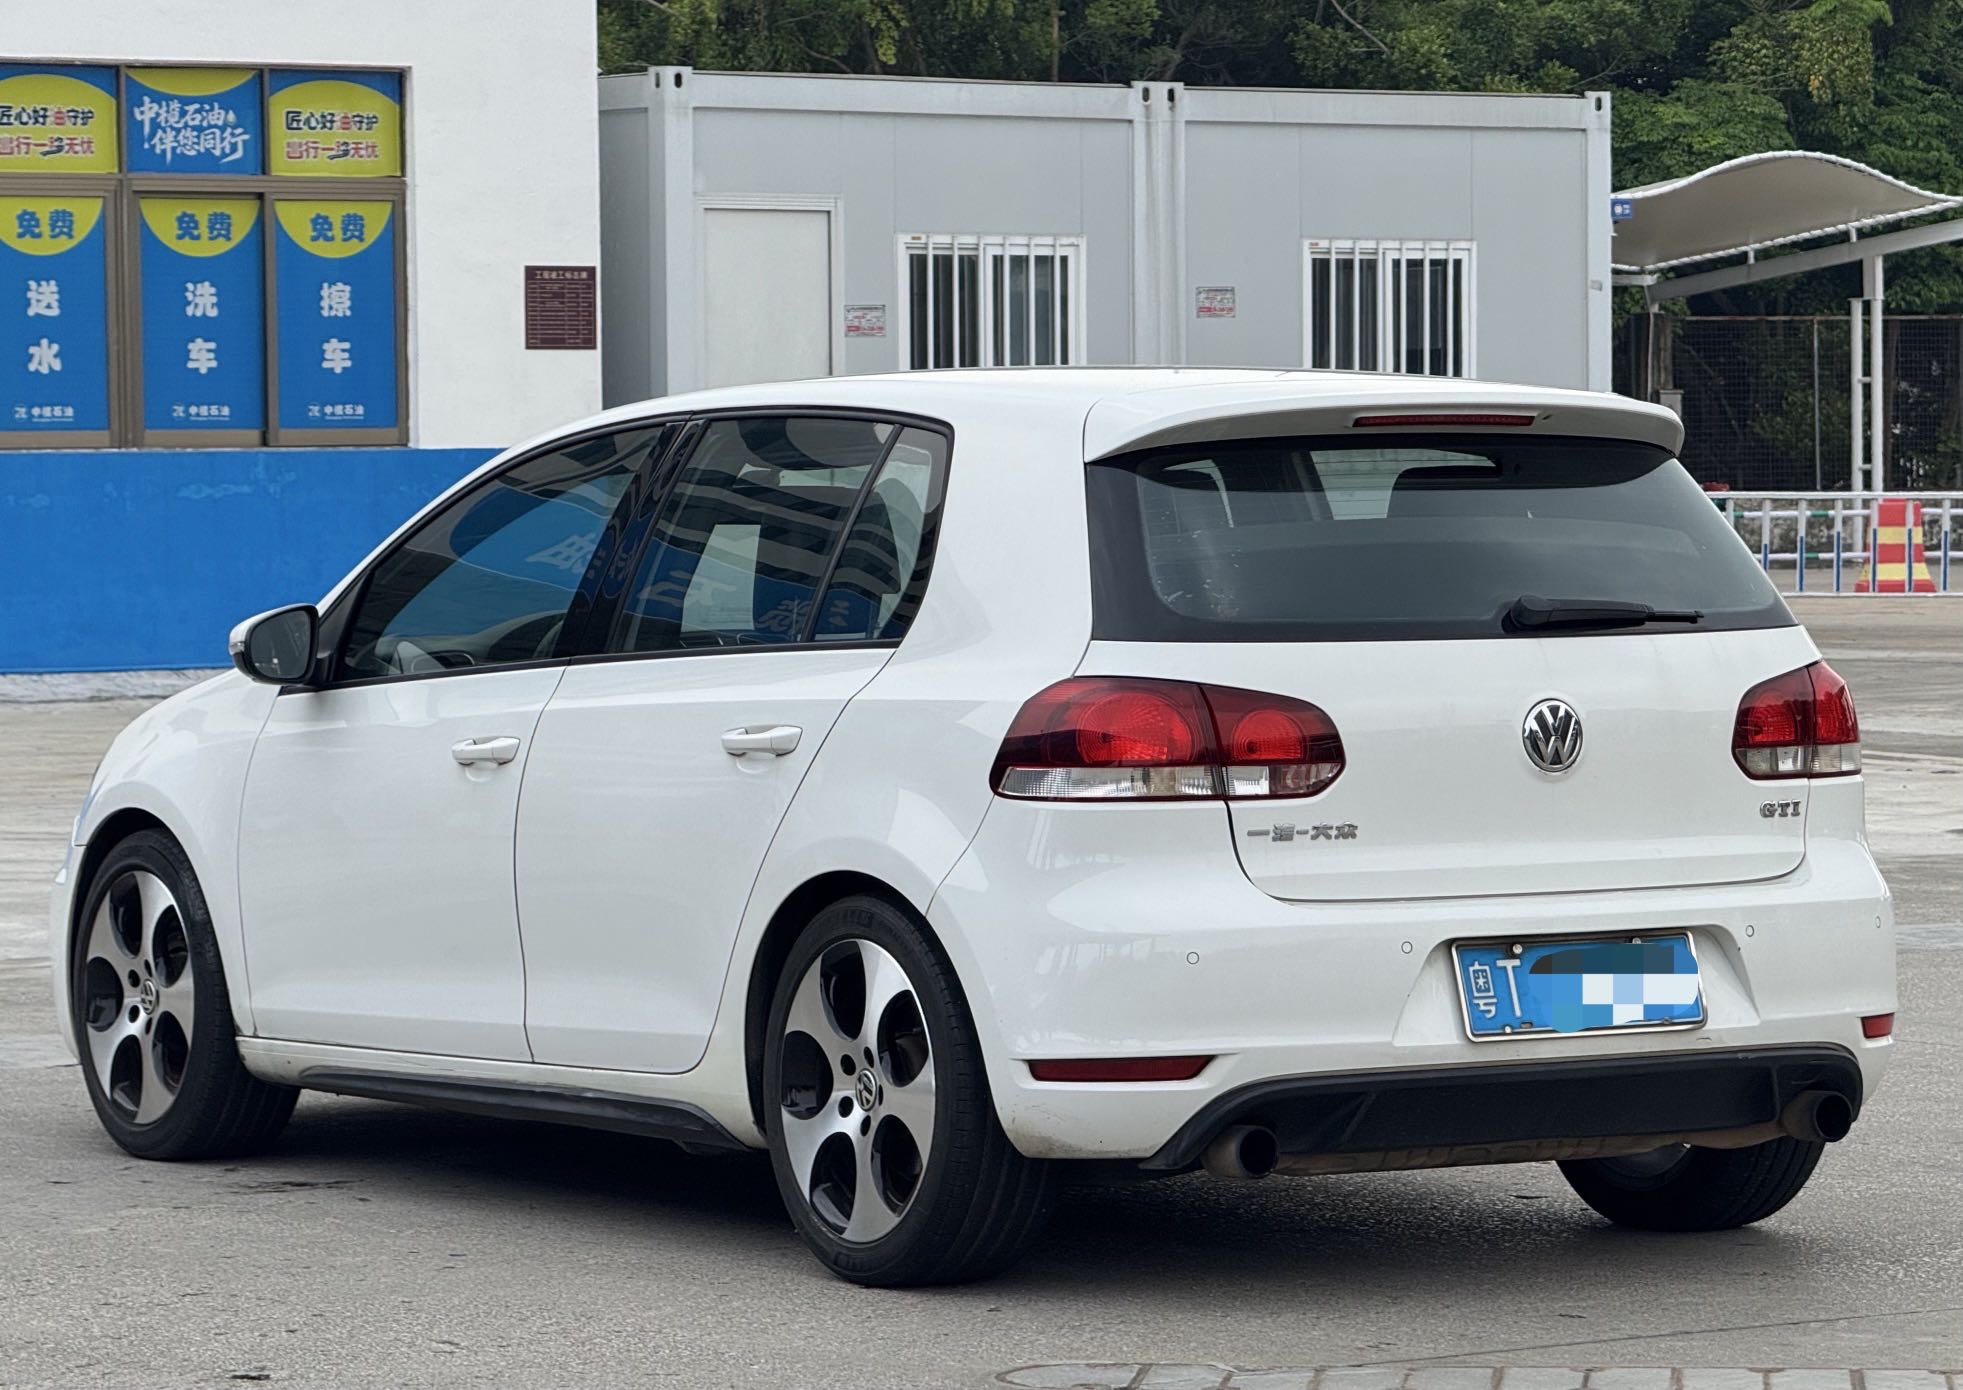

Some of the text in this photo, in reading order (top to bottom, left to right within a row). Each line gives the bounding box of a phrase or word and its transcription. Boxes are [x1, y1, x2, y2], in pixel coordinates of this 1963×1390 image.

[133, 95, 226, 137] 中榄石油
[285, 110, 379, 131] 匠心好油守护
[150, 127, 251, 165] 伴您同行
[15, 208, 75, 241] 免费
[175, 211, 233, 242] 免费
[309, 212, 366, 243] 免费
[26, 280, 63, 375] 送水
[184, 281, 219, 375] 洗车
[319, 282, 353, 375] 擦车
[1760, 800, 1801, 818] GTI
